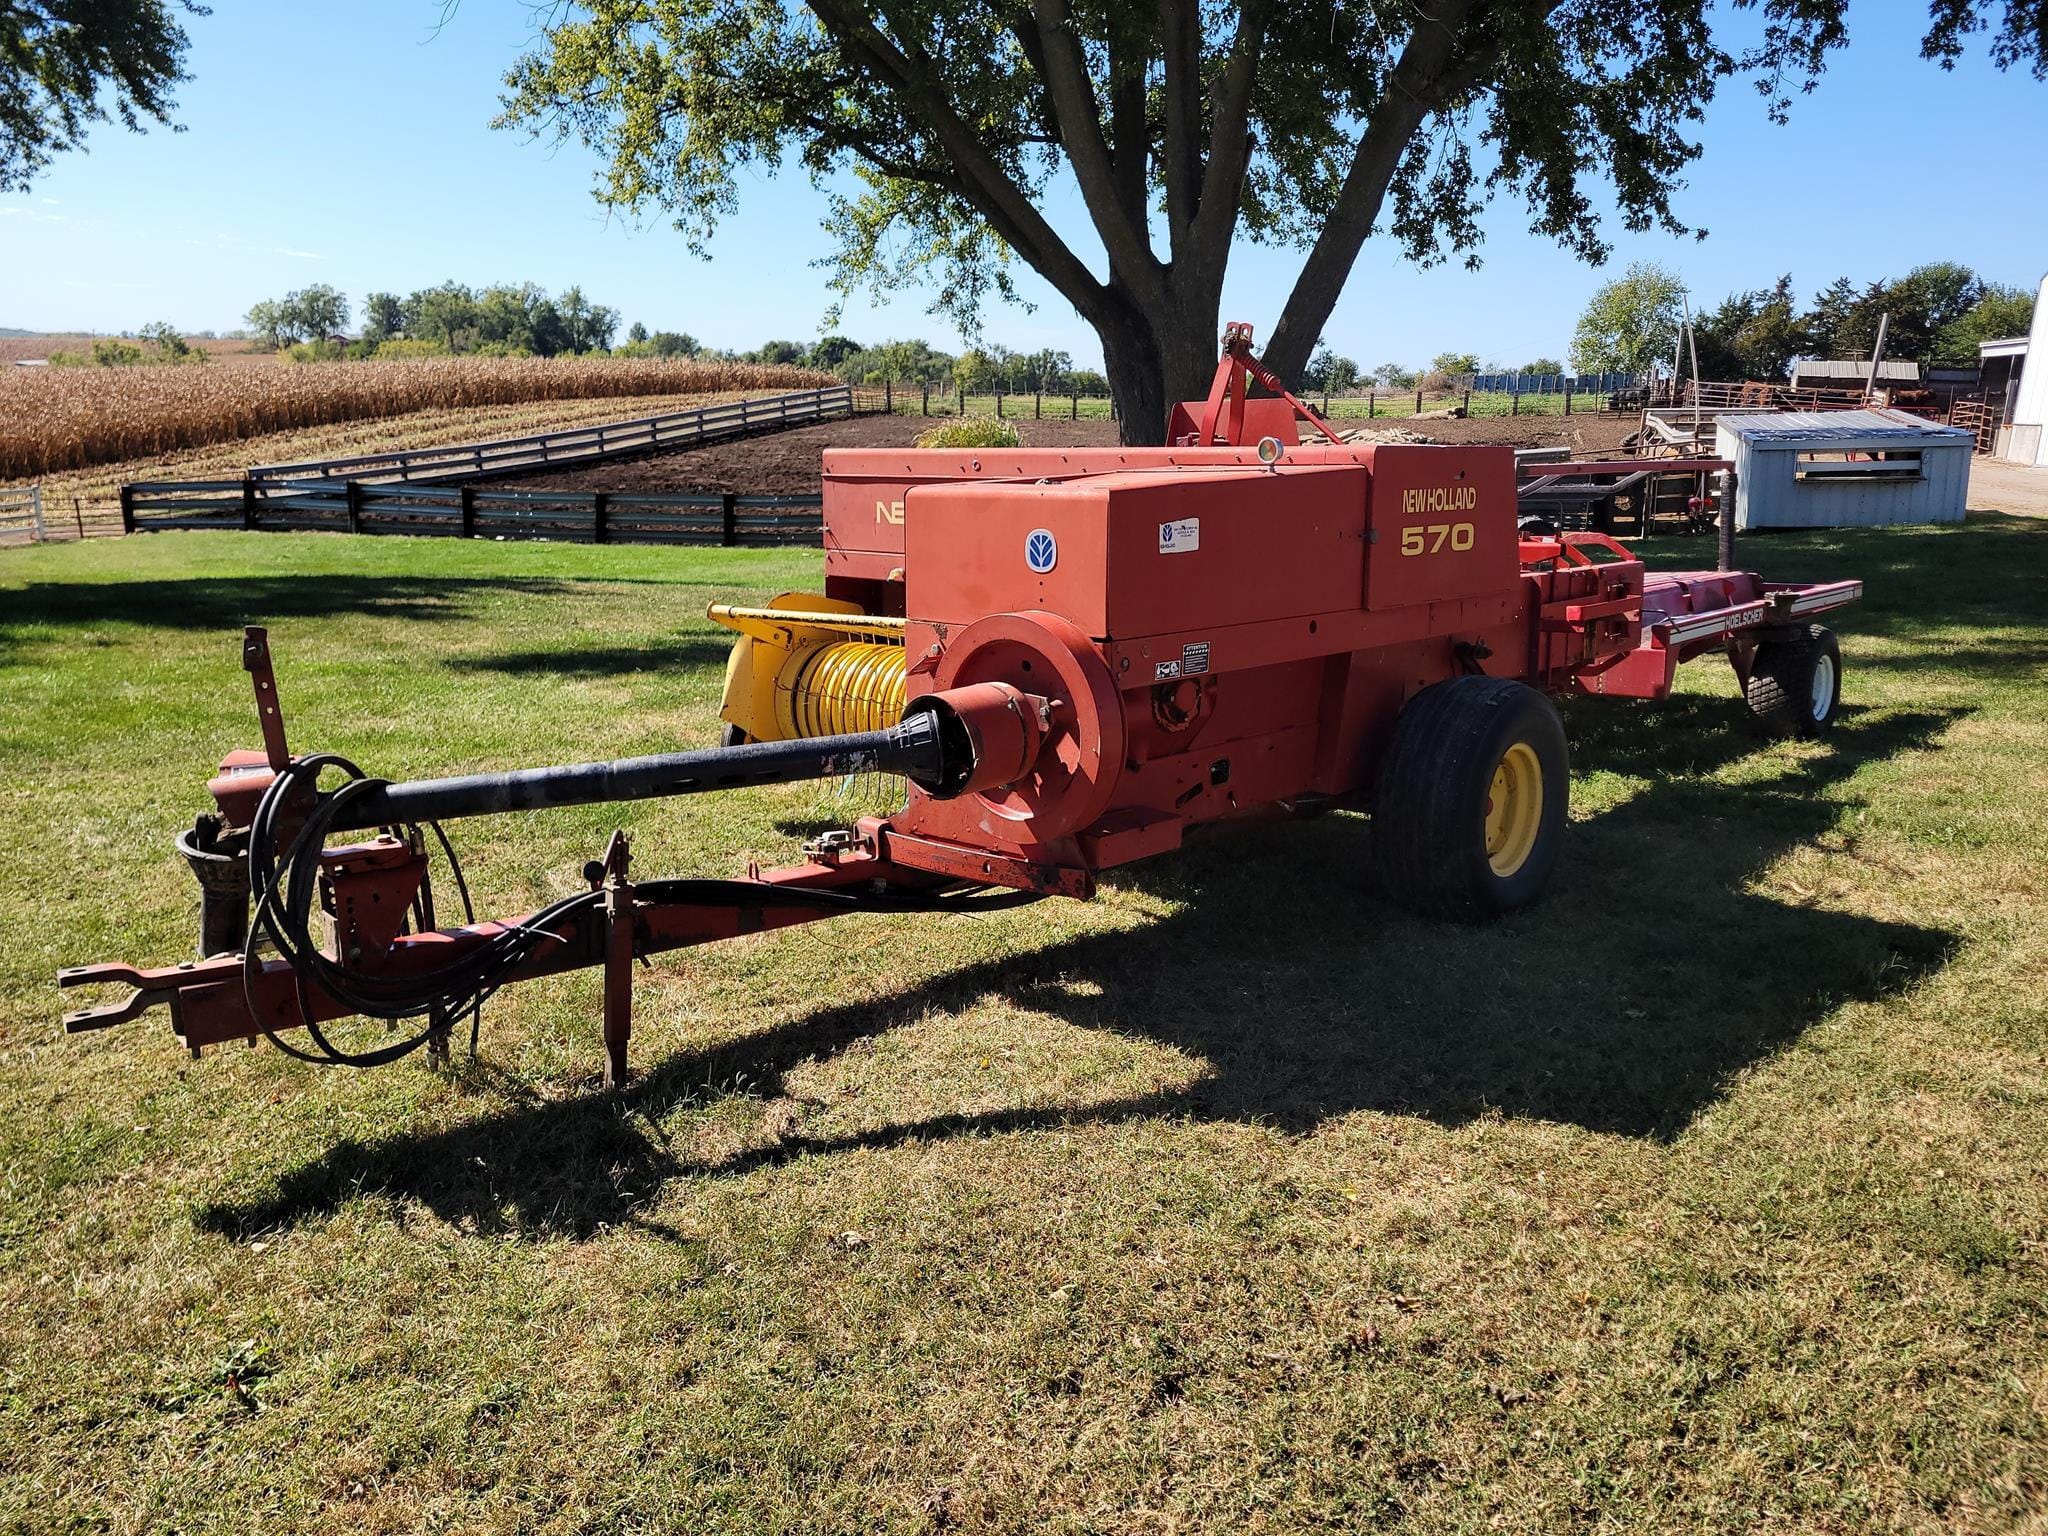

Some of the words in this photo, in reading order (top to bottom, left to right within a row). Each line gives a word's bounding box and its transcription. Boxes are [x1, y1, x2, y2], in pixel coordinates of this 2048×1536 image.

[876, 501, 905, 525] NE
[1402, 488, 1427, 514] NEW
[1427, 487, 1477, 512] HOLLAND
[1401, 522, 1475, 556] 570
[1725, 607, 1764, 630] HOELSCHER
